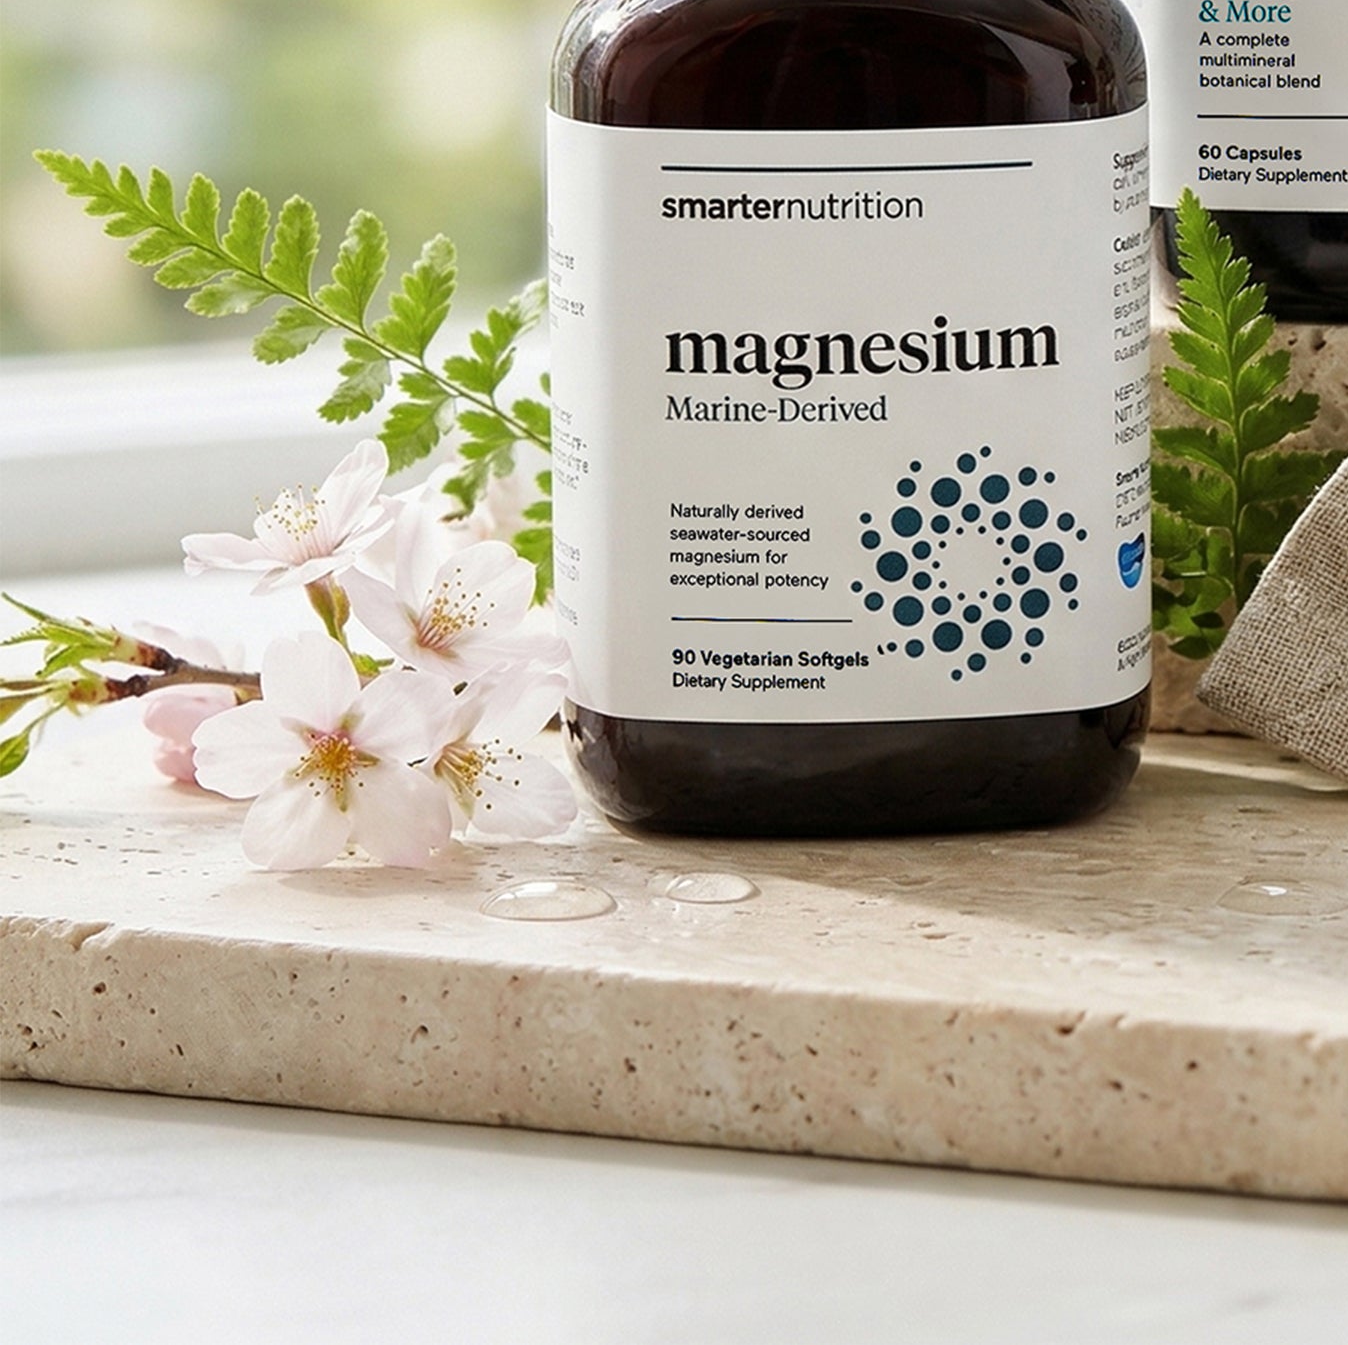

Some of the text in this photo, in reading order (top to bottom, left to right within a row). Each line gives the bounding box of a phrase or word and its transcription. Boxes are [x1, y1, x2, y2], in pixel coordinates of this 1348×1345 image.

[1199, 0, 1292, 23] & More
[1199, 31, 1289, 49] A complete
[1200, 53, 1295, 67] multimineral
[1200, 73, 1321, 88] botanical blend
[1199, 144, 1302, 163] 60 Capsules
[1199, 167, 1348, 185] Dietary Supplement
[662, 191, 923, 220] smarternutrition
[665, 316, 1060, 390] magnesium
[665, 395, 888, 422] Marine-Derived
[671, 503, 803, 521] Naturally derived
[670, 528, 810, 542] seawater-sourced
[670, 549, 788, 566] magnesium for
[670, 572, 829, 590] exceptional potency
[672, 649, 869, 670] 90 Vegetarian Softgels
[673, 672, 826, 692] Dietary Supplement
